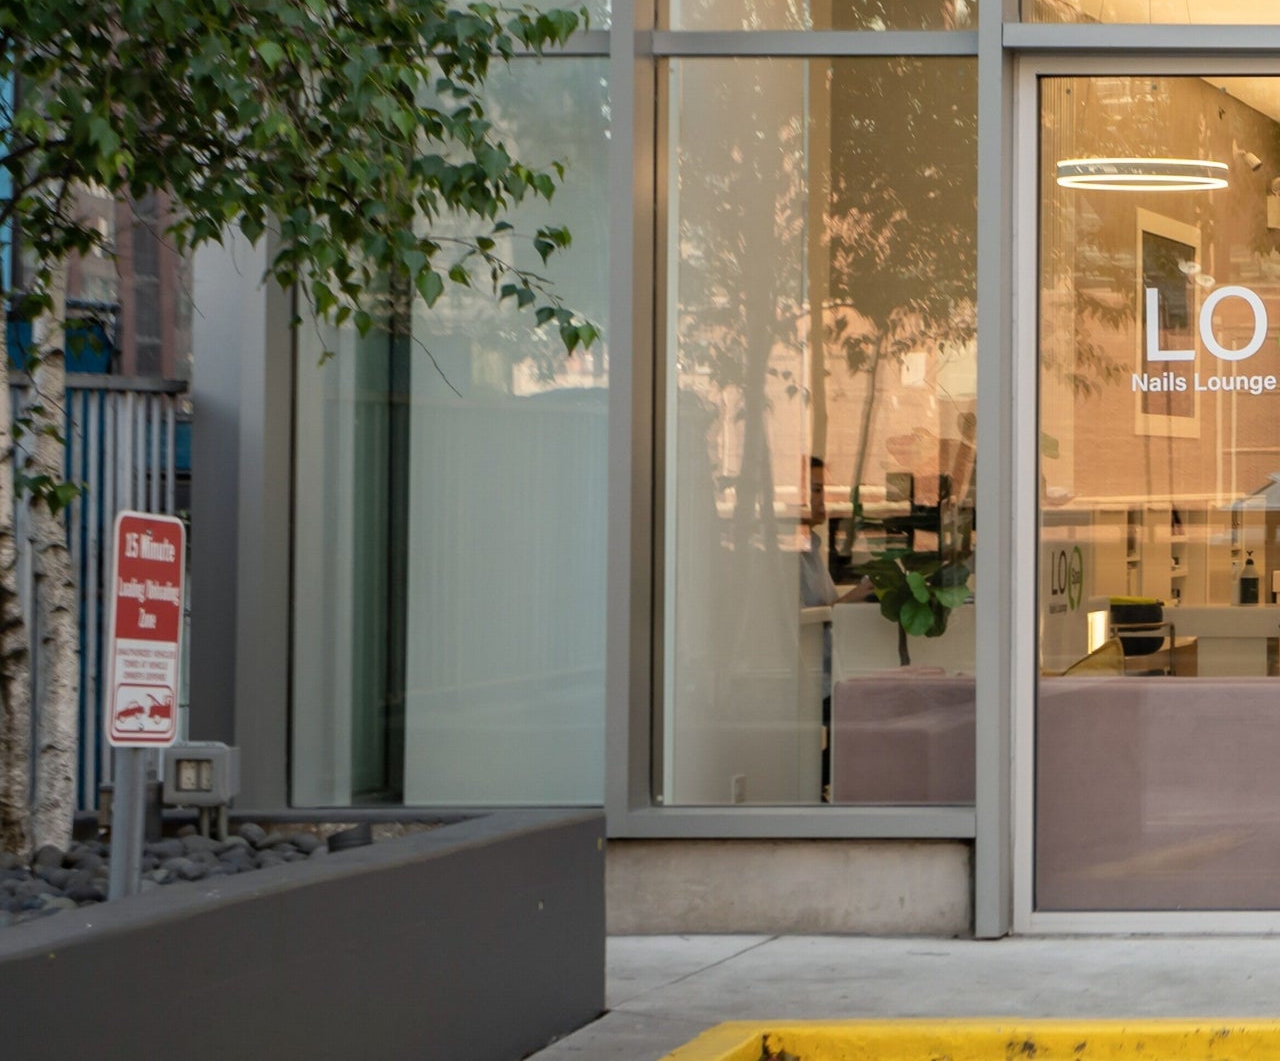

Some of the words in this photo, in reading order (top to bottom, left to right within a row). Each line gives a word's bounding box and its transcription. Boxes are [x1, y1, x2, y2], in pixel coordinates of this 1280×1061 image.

[1145, 285, 1268, 362] LO
[1131, 372, 1188, 392] Nails
[1194, 372, 1277, 396] Lounge
[125, 532, 139, 558] 15
[140, 533, 176, 563] Minute
[138, 607, 157, 629] Zone
